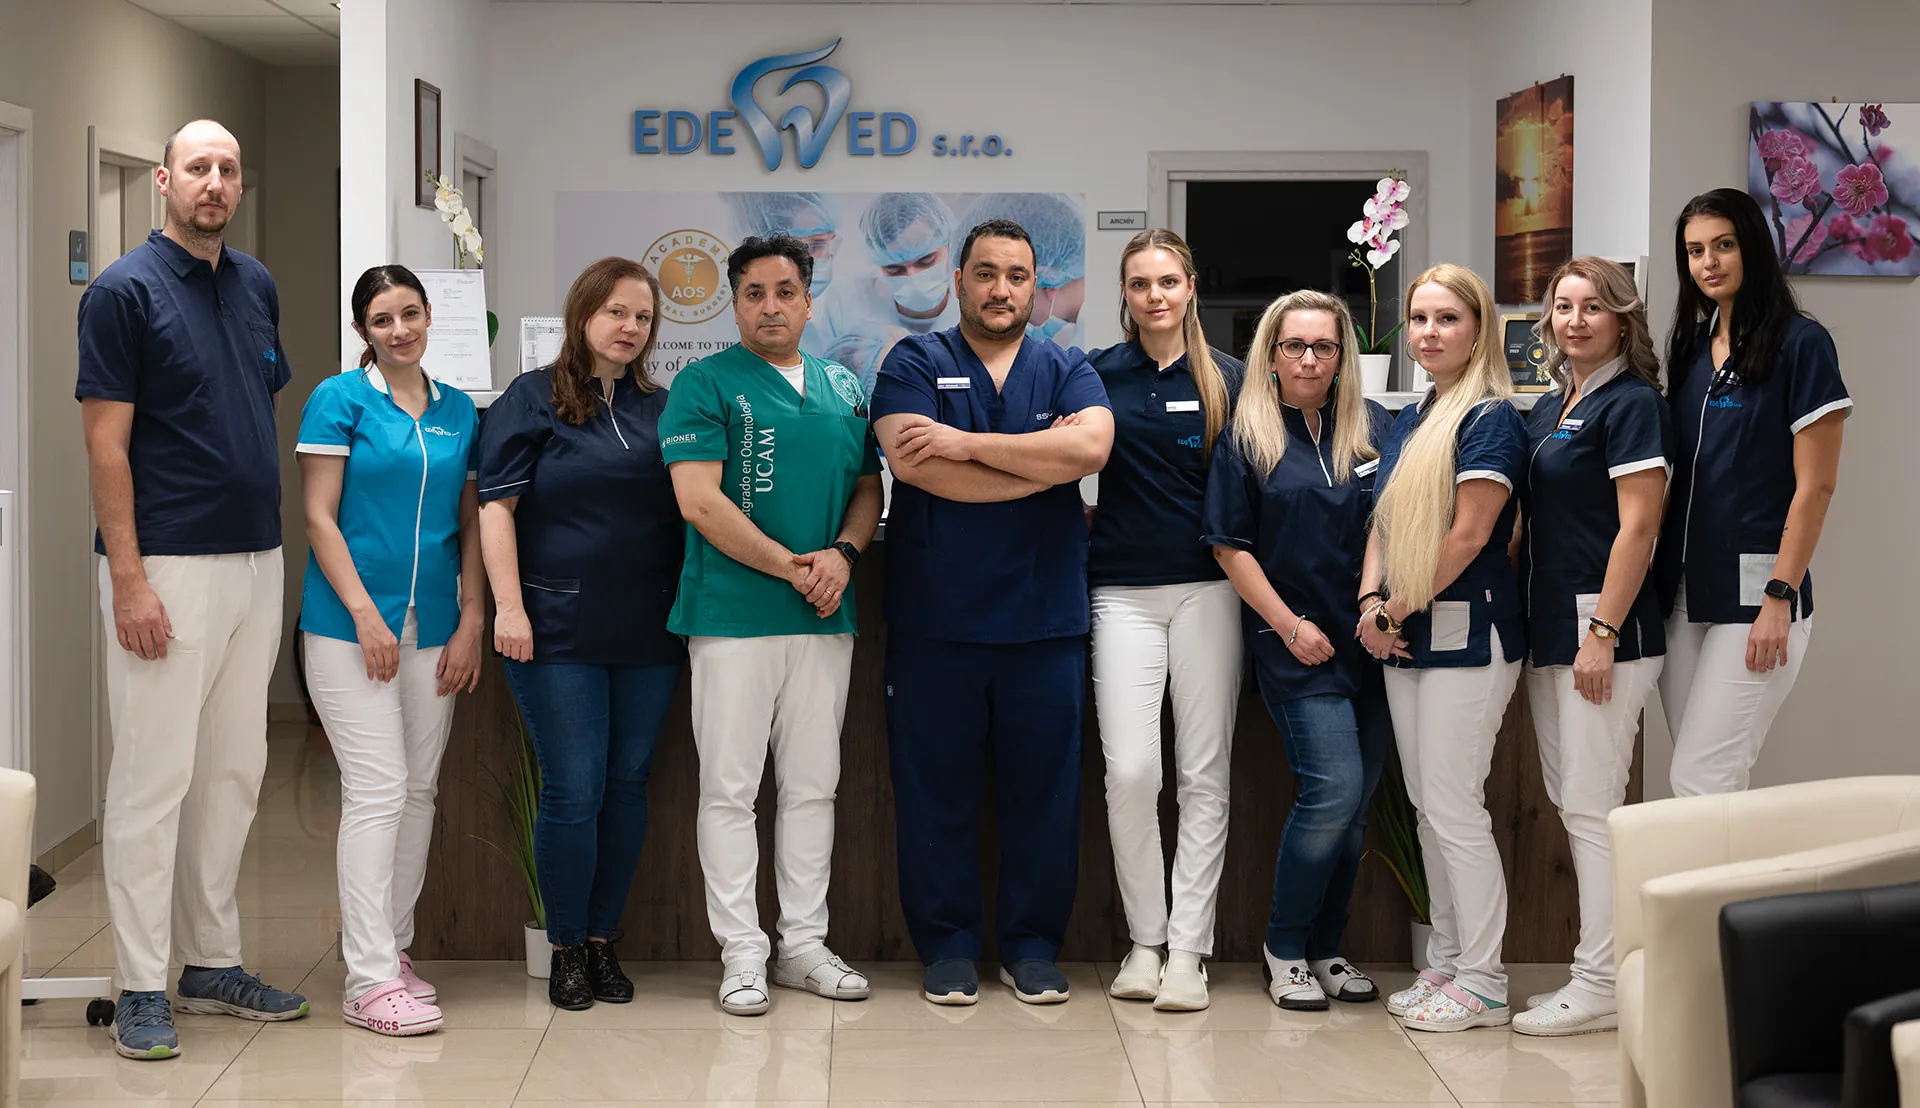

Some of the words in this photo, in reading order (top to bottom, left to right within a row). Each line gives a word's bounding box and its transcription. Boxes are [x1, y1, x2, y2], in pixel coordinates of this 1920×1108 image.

[933, 134, 1013, 156] s.r.o.
[650, 235, 729, 265] ACADEMY
[671, 286, 706, 299] AOS
[656, 341, 694, 351] LCOME
[697, 341, 712, 351] TO
[665, 356, 682, 372] of
[735, 394, 754, 458] Odontología
[666, 433, 697, 444] BIONER
[742, 460, 752, 474] en
[755, 427, 776, 493] UCAM
[367, 1017, 399, 1031] crocs
